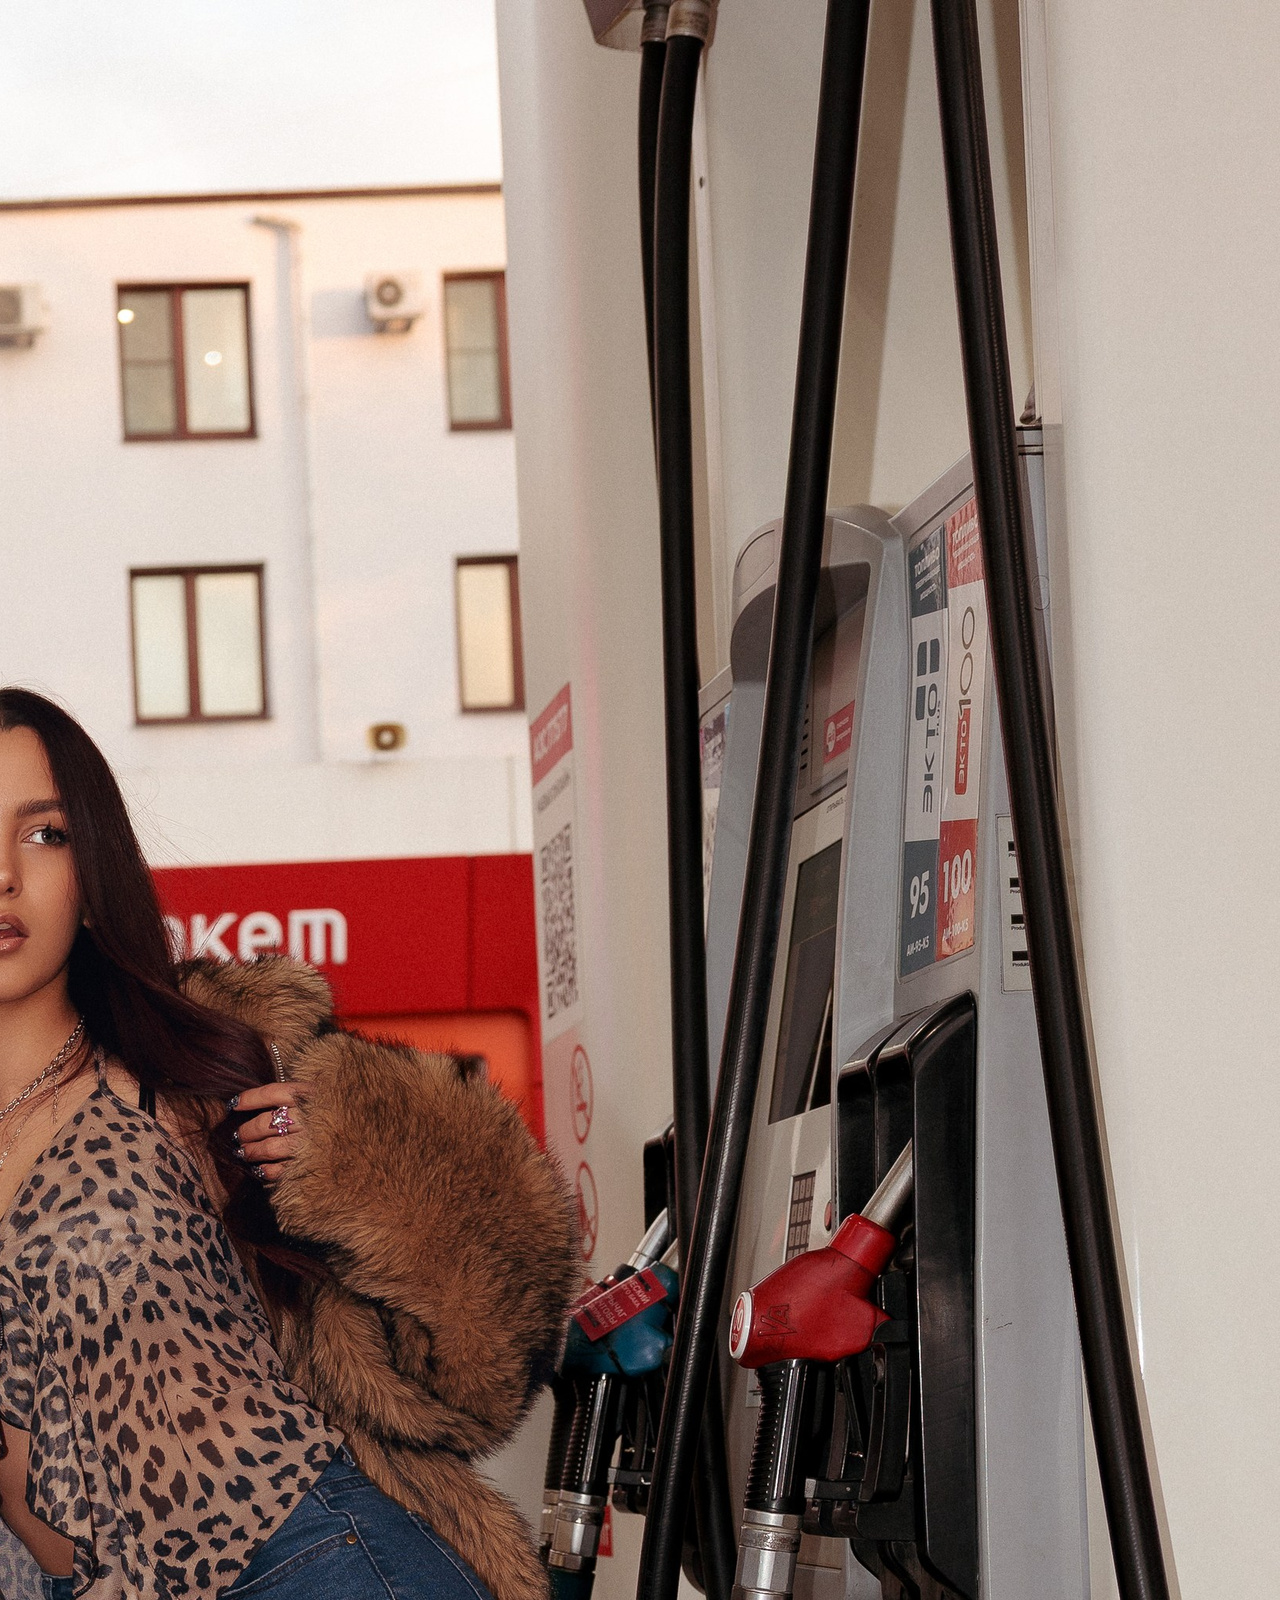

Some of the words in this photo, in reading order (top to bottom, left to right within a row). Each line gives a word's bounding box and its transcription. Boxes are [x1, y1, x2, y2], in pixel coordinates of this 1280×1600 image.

[922, 683, 938, 813] ЭКТО
[909, 870, 930, 919] 95
[942, 849, 972, 903] 100
[163, 908, 348, 966] кет
